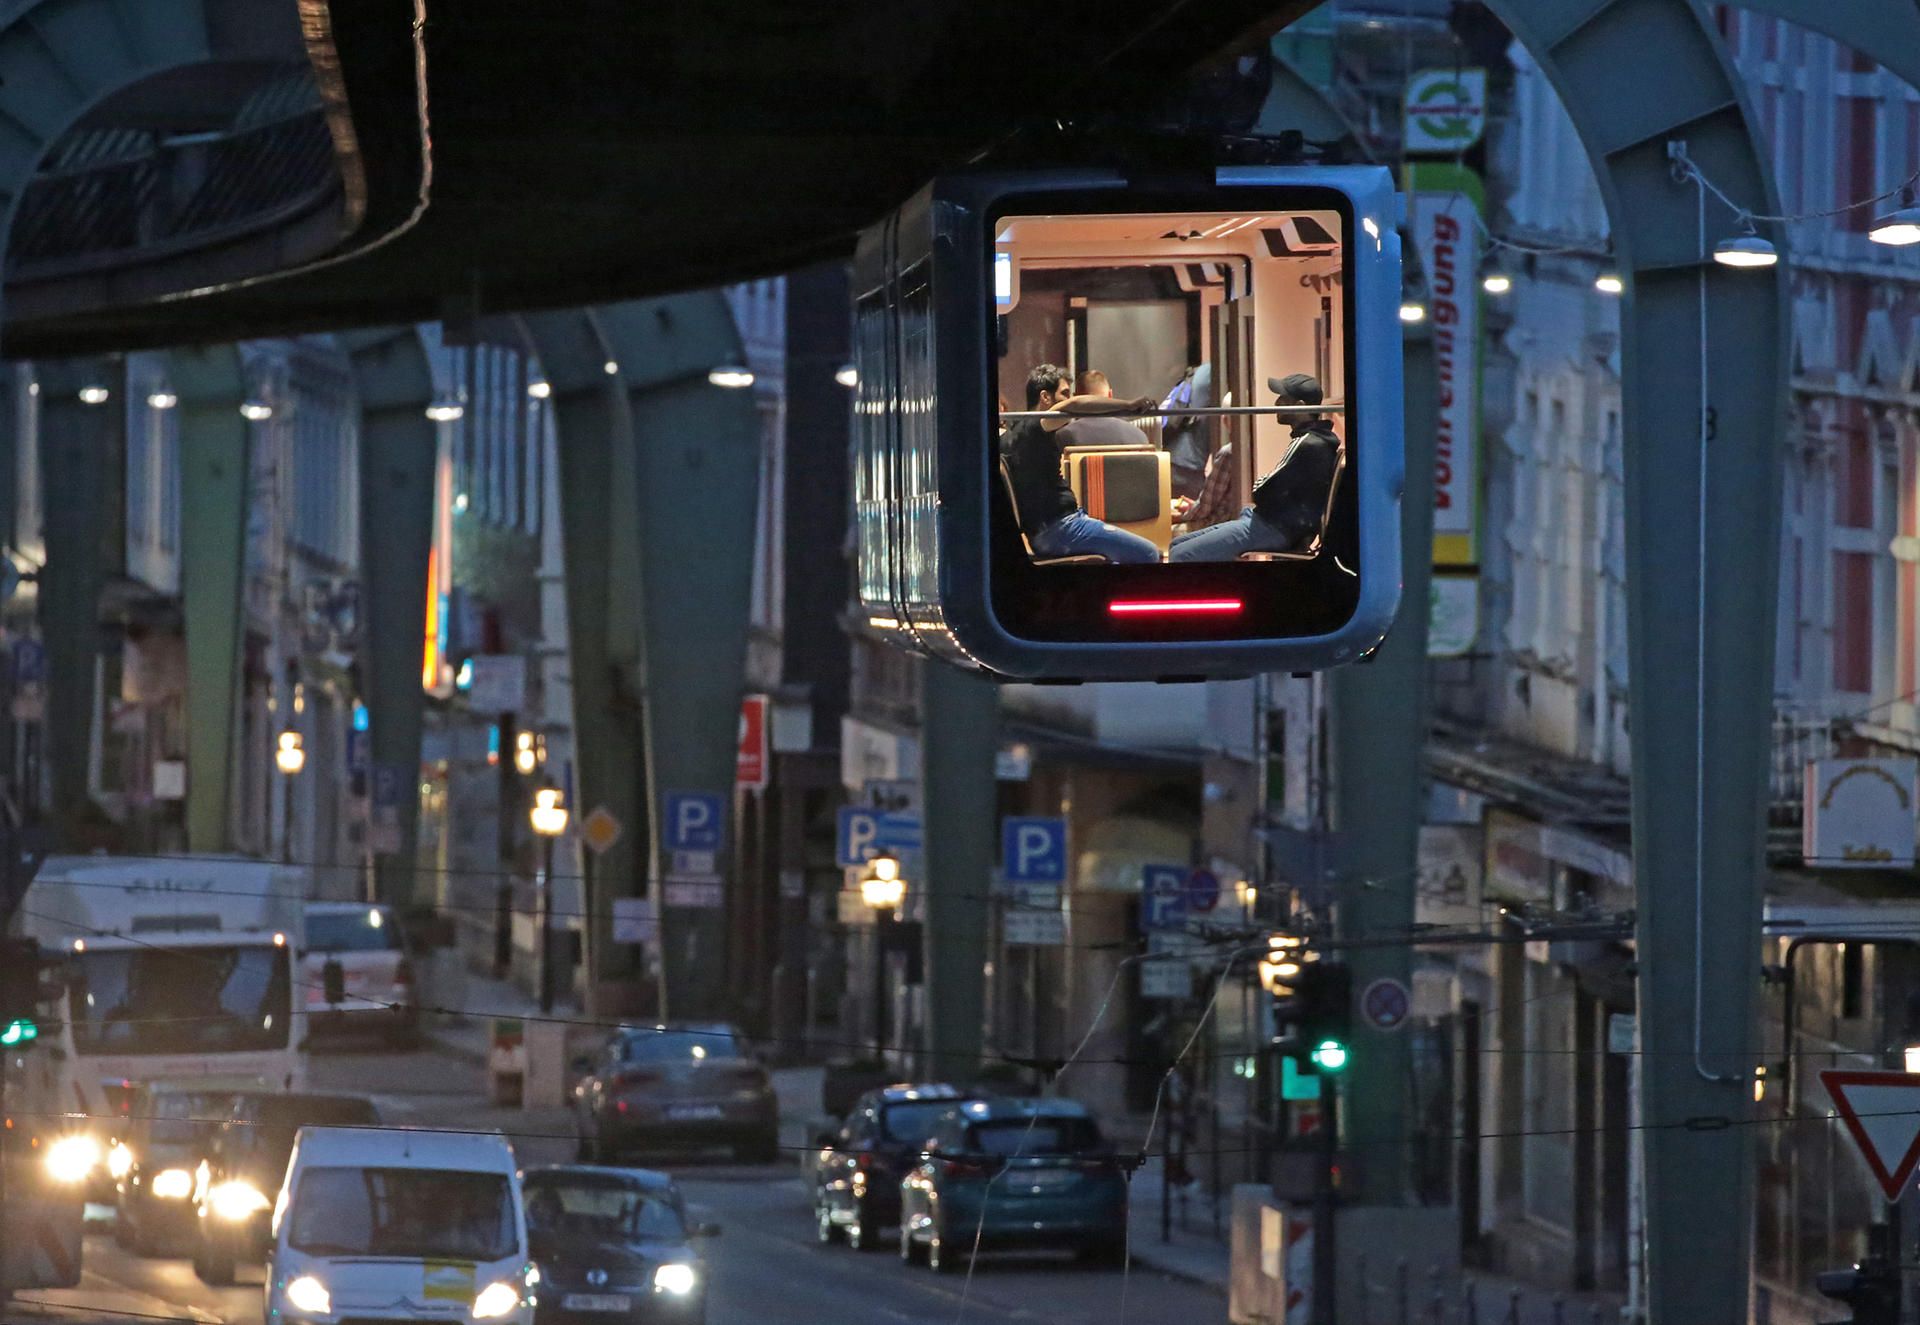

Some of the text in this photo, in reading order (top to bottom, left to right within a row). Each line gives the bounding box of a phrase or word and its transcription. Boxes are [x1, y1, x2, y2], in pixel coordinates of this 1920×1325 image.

[678, 799, 710, 843] P
[850, 815, 876, 860] P
[1017, 824, 1051, 876] P
[1153, 872, 1181, 924] P
